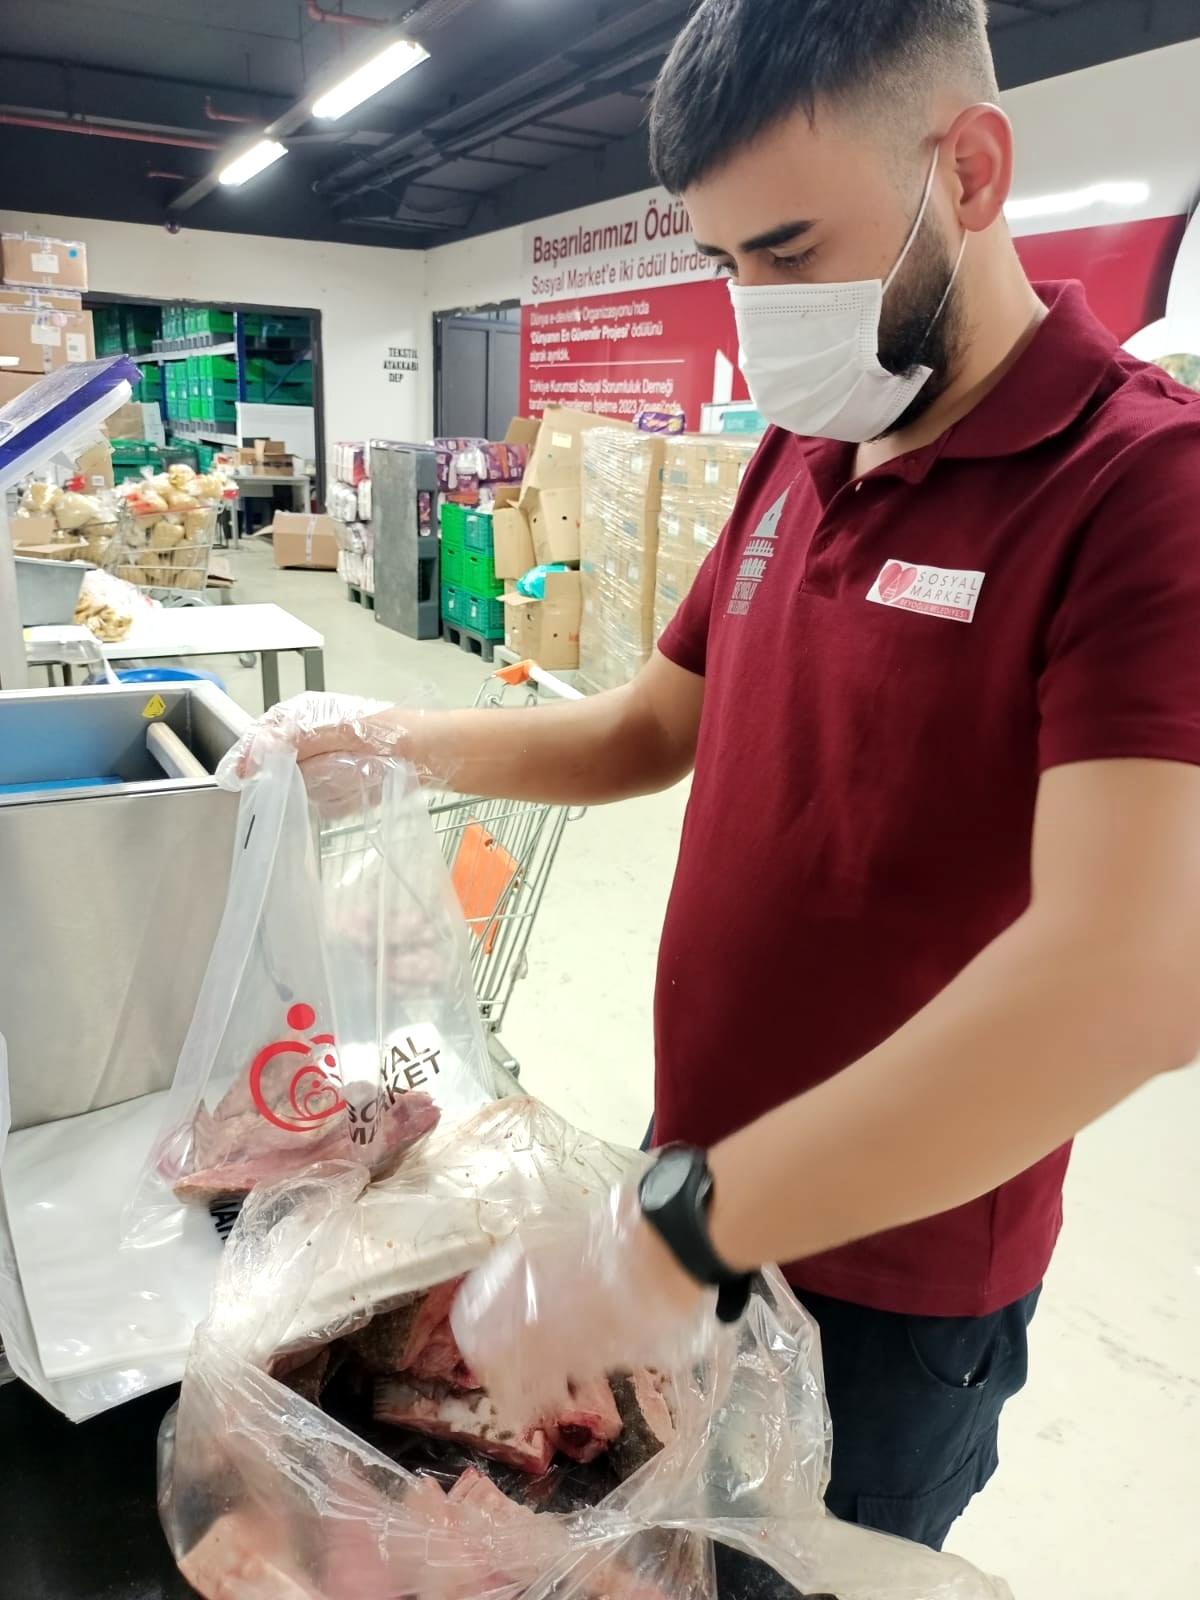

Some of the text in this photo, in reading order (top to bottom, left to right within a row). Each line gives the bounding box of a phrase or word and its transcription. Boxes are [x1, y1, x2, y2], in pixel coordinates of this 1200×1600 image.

[533, 199, 693, 268] Başarılarımızı Ödül
[531, 271, 565, 297] Sosyal
[619, 258, 635, 282] iki
[637, 252, 667, 279] ödül
[551, 379, 578, 393] Kurumsal
[579, 379, 601, 396] Sosyal
[602, 378, 642, 394] Sorumluluk
[643, 378, 673, 397] Derneği
[619, 399, 637, 414] 2023
[917, 571, 978, 591] SOSYAL
[909, 584, 975, 606] MARKET
